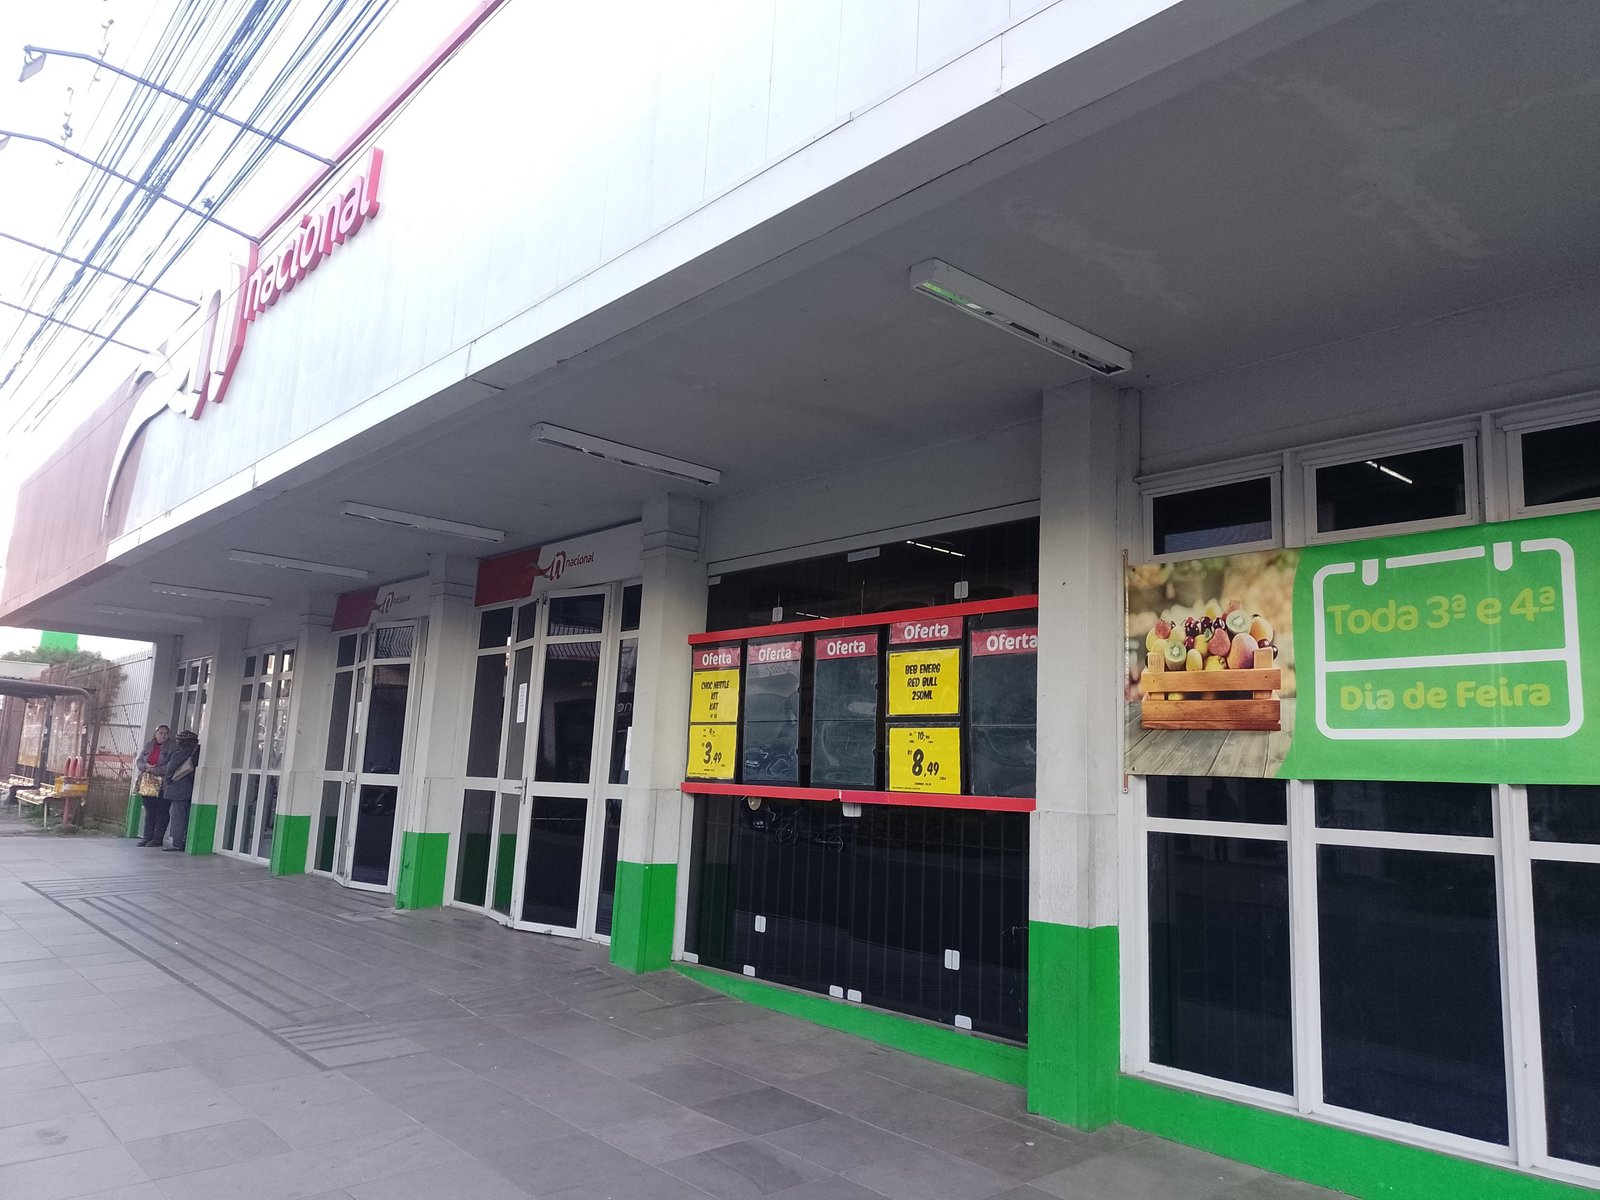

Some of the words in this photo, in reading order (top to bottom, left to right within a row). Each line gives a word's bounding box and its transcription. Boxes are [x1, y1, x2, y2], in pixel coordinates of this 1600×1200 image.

[243, 146, 384, 322] nacional
[565, 552, 595, 568] nacional
[1327, 599, 1420, 635] Toda
[1476, 596, 1503, 625] e
[904, 624, 949, 640] Oferta
[827, 640, 866, 656] Oferta
[986, 633, 1038, 651] Oferta
[702, 653, 732, 666] Oferta
[758, 647, 792, 662] Oferta
[905, 665, 918, 675] BEB
[919, 663, 941, 674] ENERG
[907, 678, 920, 688] RED
[922, 677, 938, 687] BULL
[911, 690, 933, 700] 250ML
[1340, 682, 1396, 711] Dia
[1403, 681, 1448, 710] de
[1456, 677, 1552, 708] Feira
